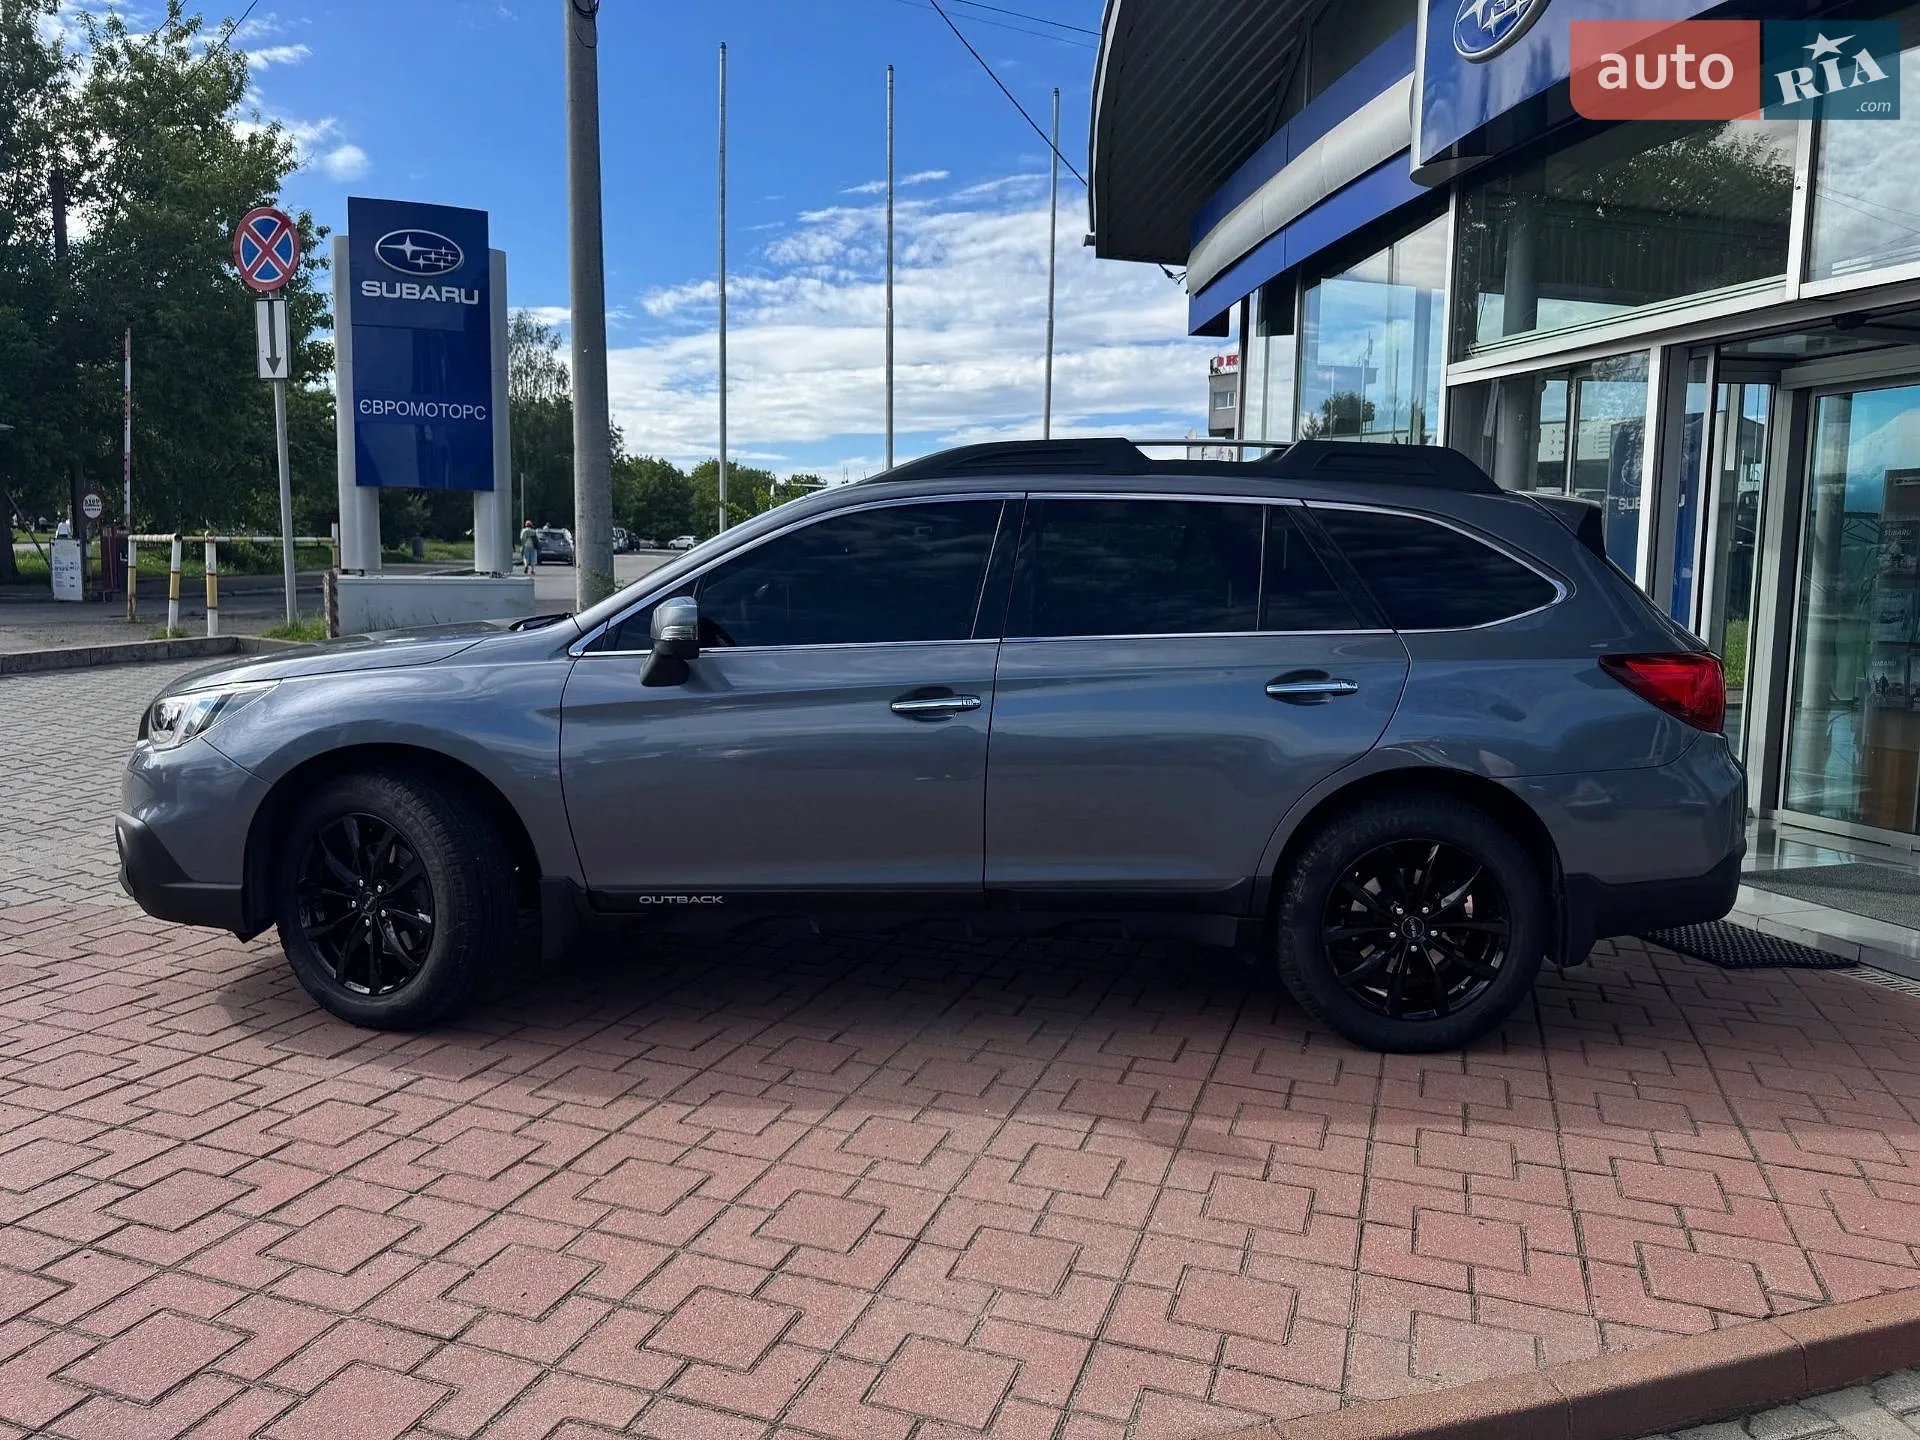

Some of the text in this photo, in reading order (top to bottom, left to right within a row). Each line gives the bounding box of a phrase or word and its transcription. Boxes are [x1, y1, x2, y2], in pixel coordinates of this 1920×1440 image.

[361, 280, 479, 305] SUBARU
[360, 399, 487, 420] ЄВРОМОТОРС
[639, 895, 725, 904] OUTBACK
